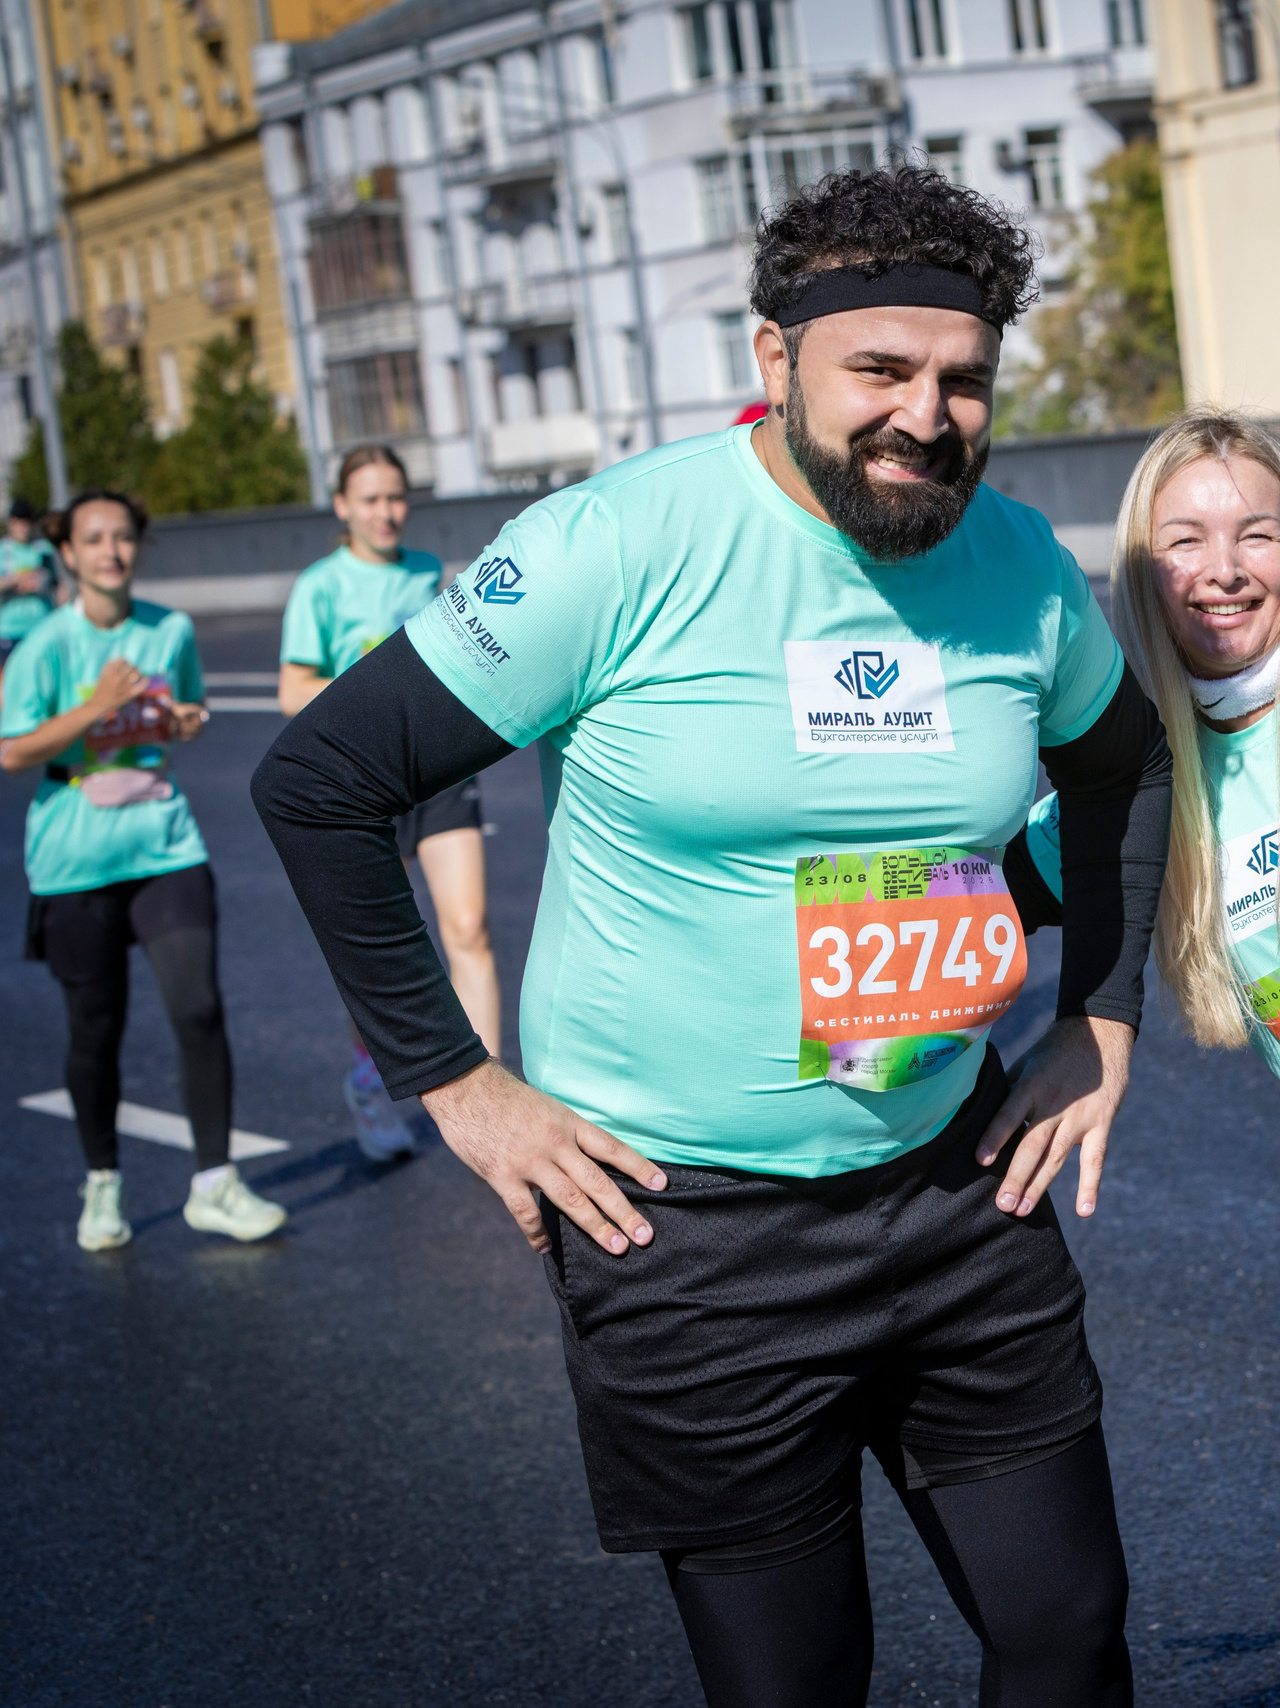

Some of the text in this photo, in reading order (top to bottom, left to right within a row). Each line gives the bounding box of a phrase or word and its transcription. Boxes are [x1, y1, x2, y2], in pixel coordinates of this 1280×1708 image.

[446, 581, 511, 664] РАЛЬ АУДИТ
[436, 596, 496, 677] алтерские услуги
[808, 711, 933, 728] МИРАЛЬ АУДИТ
[811, 730, 938, 744] Бухгалтерские услуги
[805, 873, 867, 886] 23/08
[952, 862, 991, 875] 10 КМ
[962, 876, 994, 885] 2026
[1226, 884, 1276, 918] МИРАЛЬ
[808, 913, 1018, 999] 32749
[814, 1000, 1012, 1029] ФЕСТИВАЛЬ ДВИЖЕНИЯ
